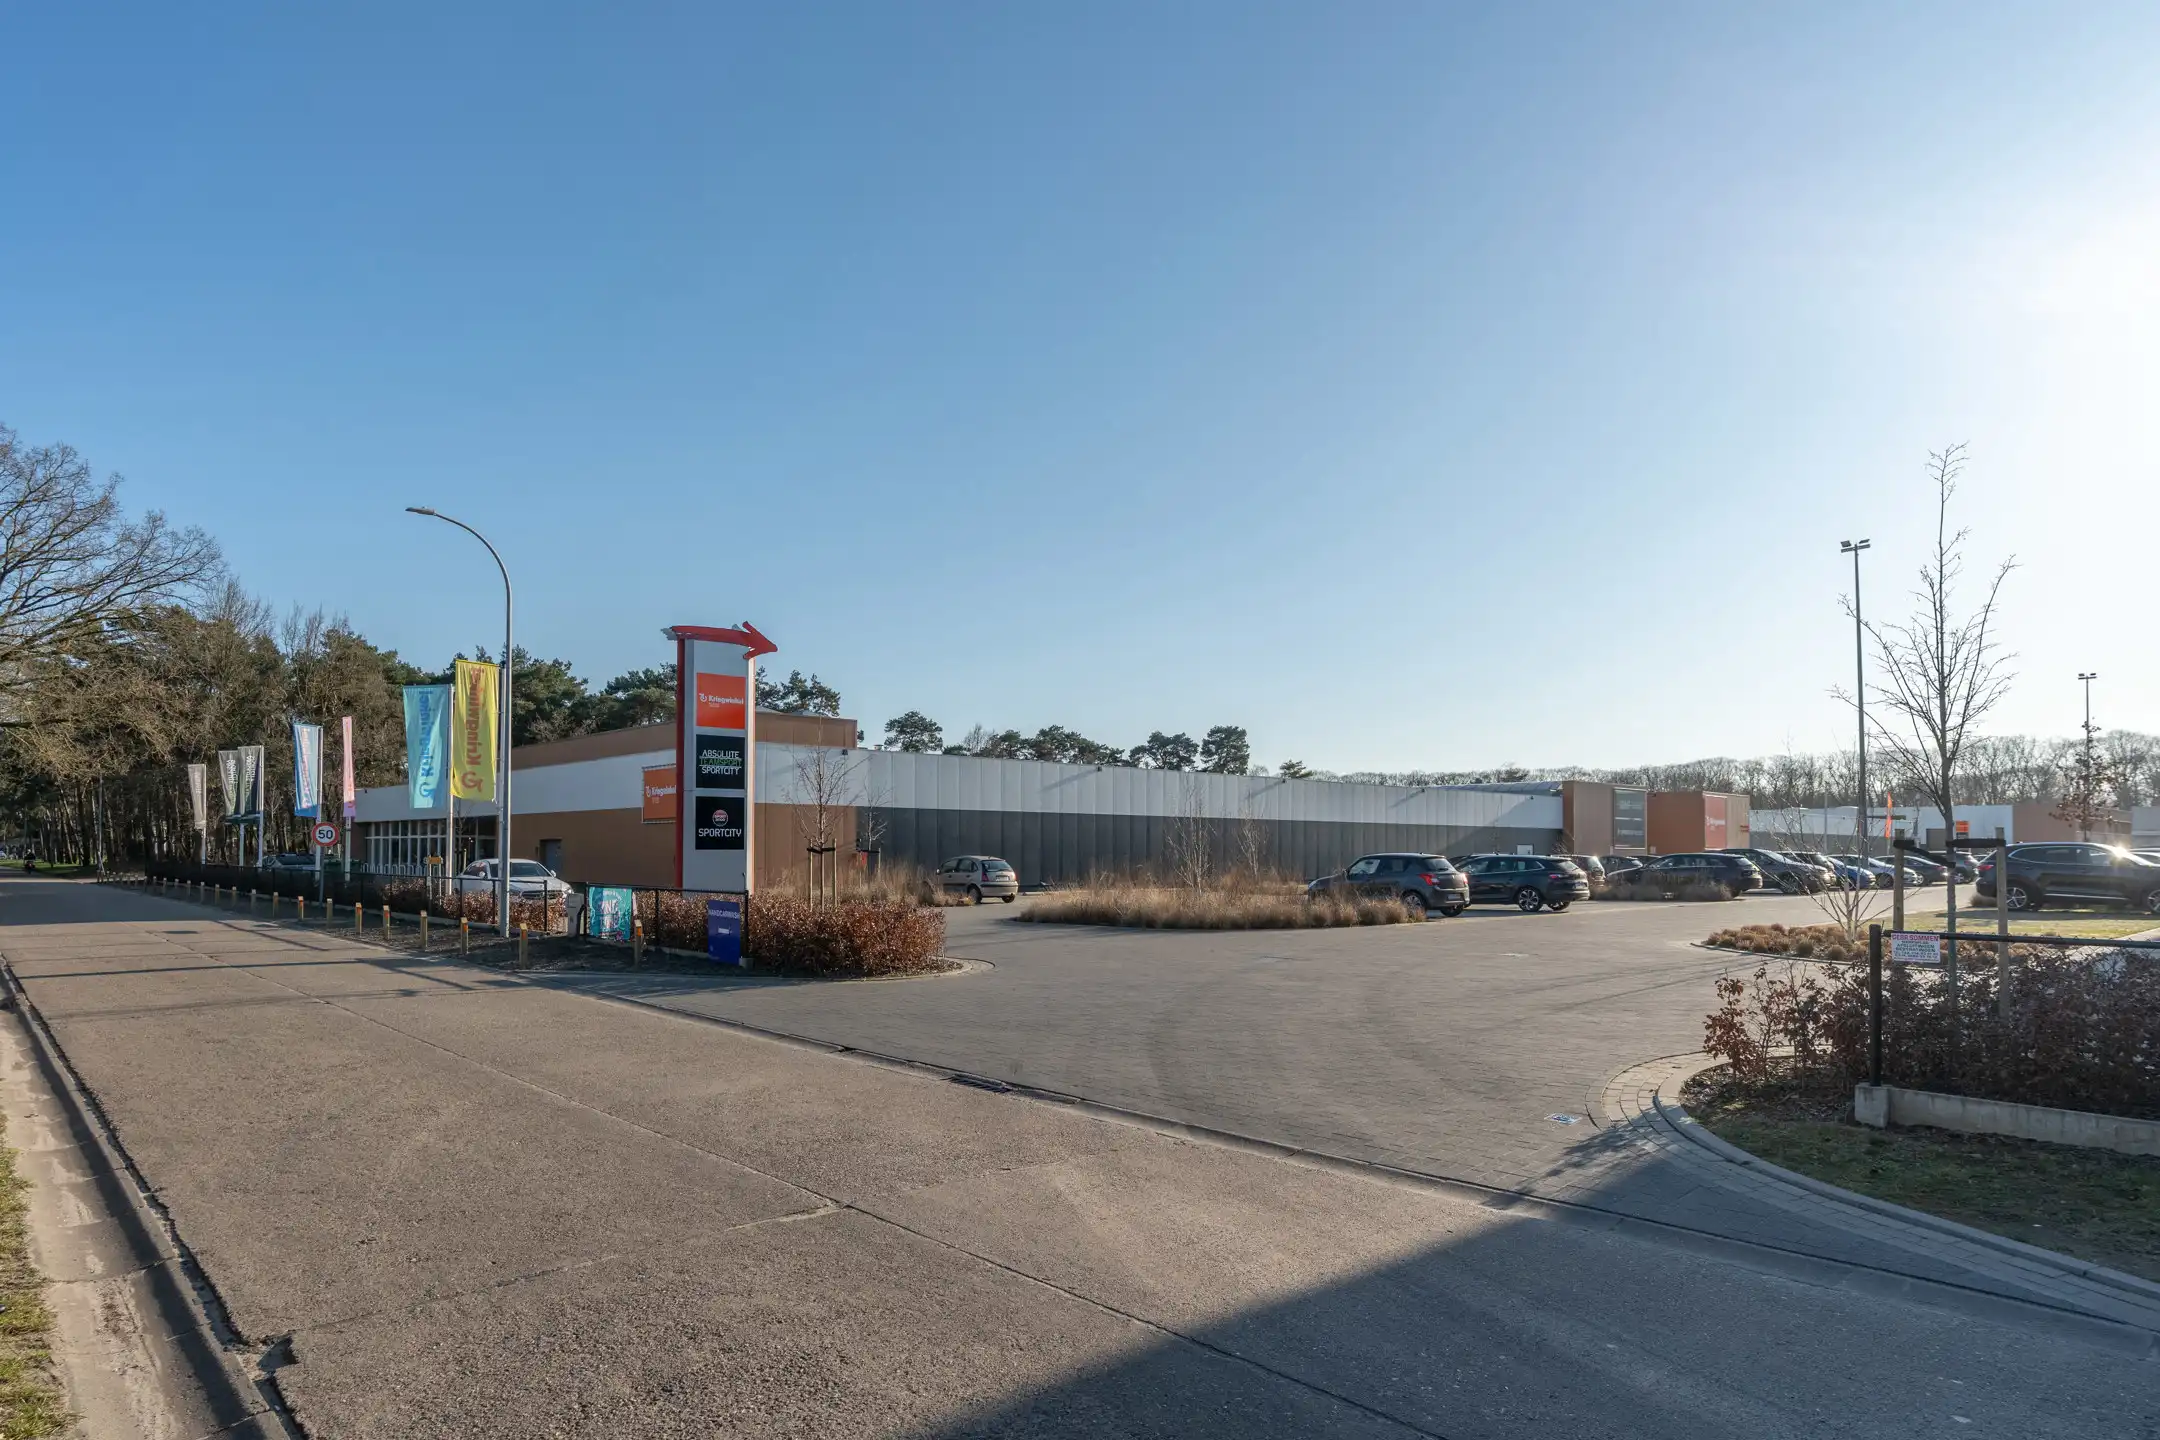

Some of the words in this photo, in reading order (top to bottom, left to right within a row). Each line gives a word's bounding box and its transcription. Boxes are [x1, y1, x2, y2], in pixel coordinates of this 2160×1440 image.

[702, 750, 740, 759] ABSOLUTE
[700, 758, 742, 767] TEAMSPORT
[701, 766, 740, 775] SPORTCITY
[318, 829, 334, 840] 50
[698, 828, 742, 837] SPORTCITY
